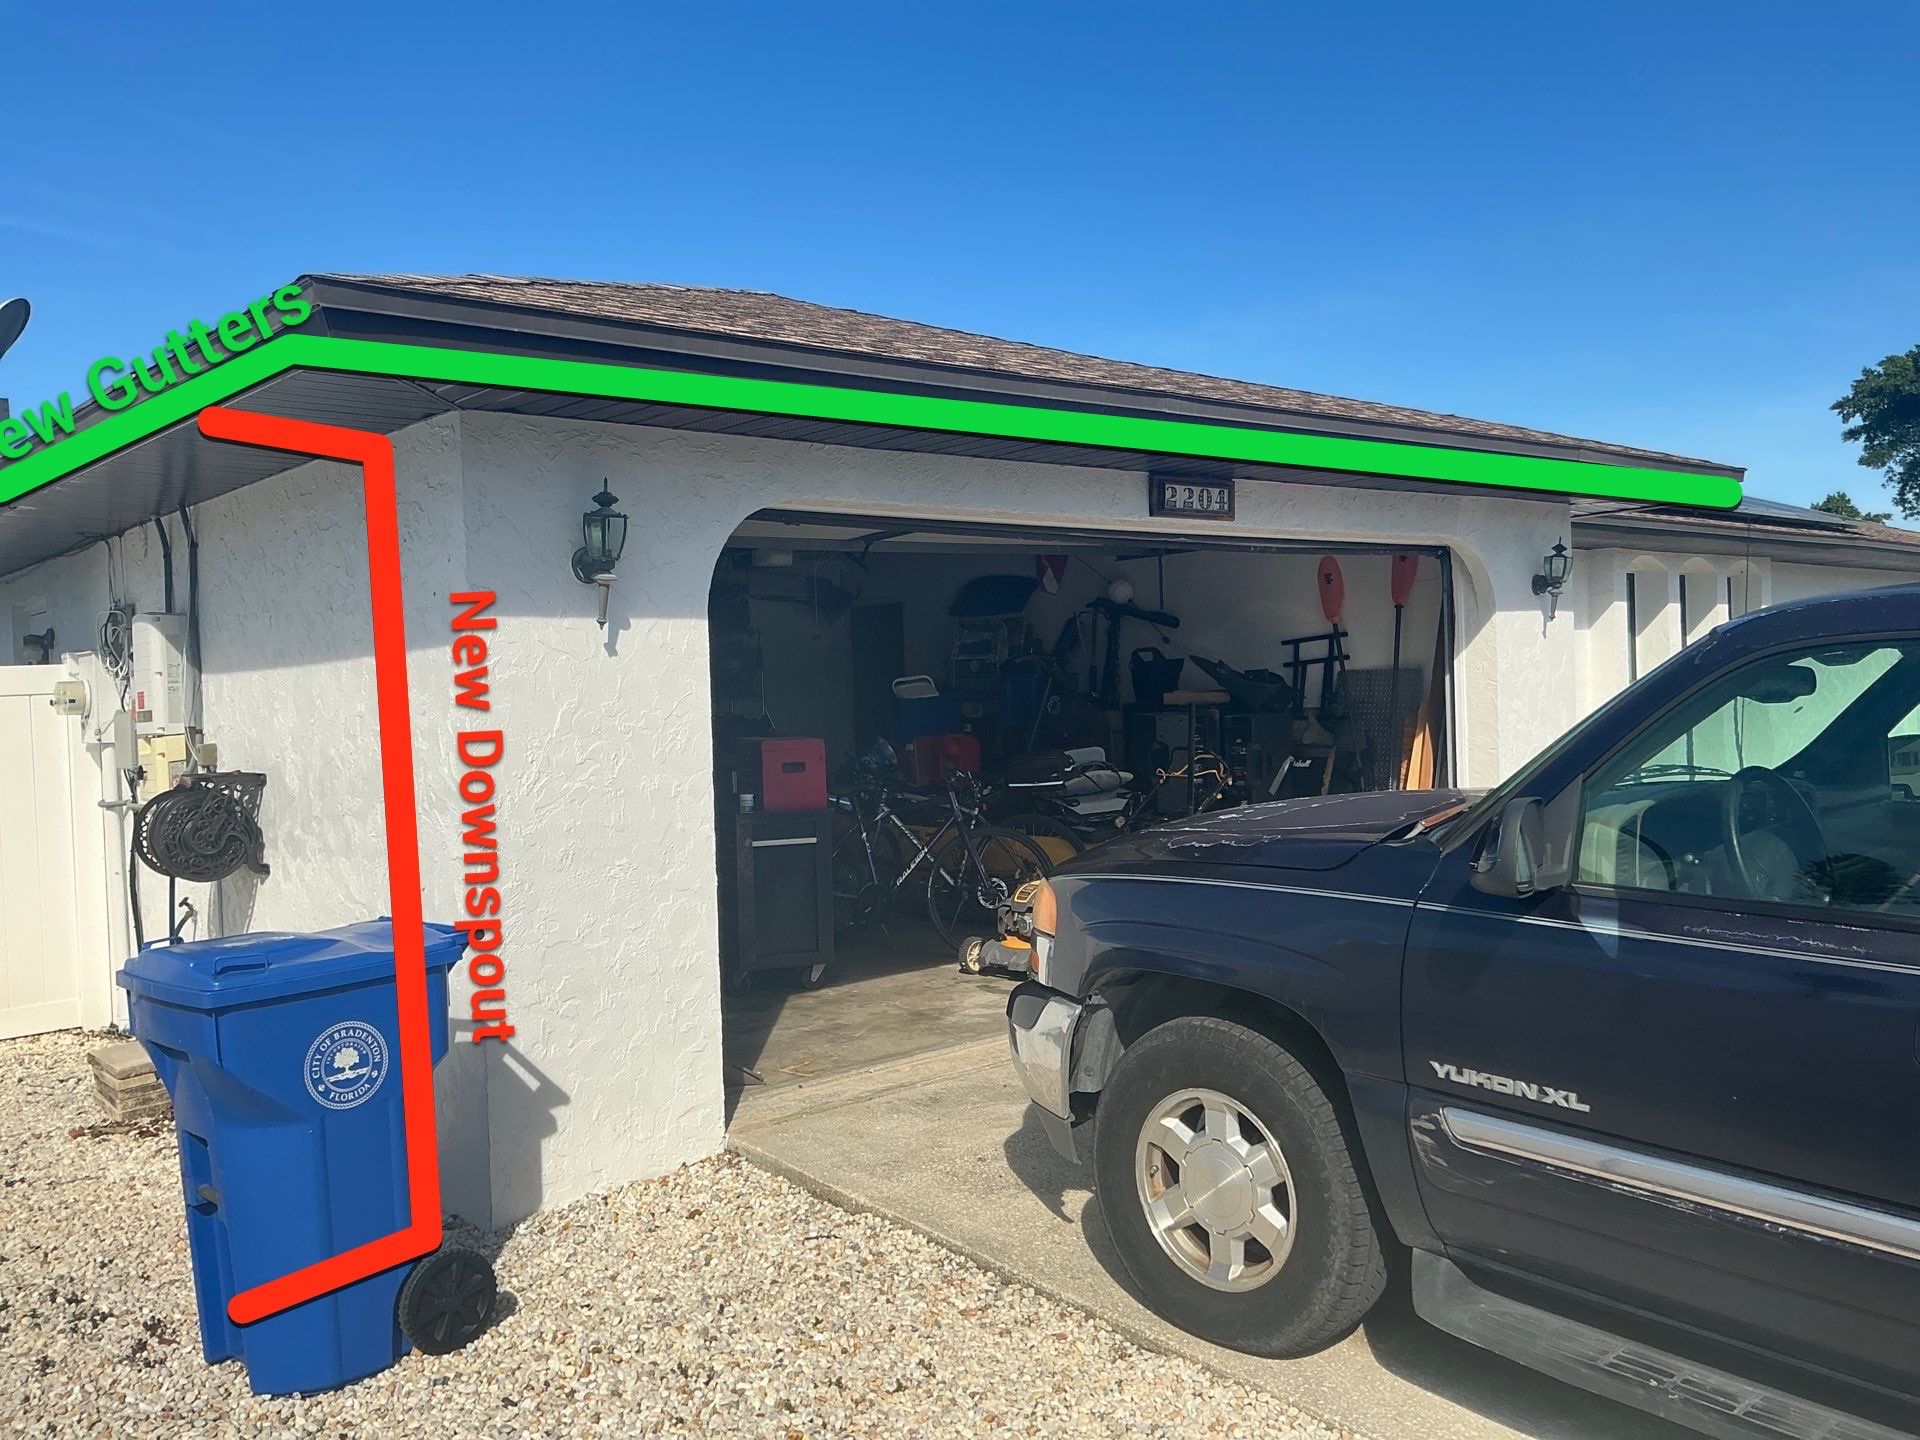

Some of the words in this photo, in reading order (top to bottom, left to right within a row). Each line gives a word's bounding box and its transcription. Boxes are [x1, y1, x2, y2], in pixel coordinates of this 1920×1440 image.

[1166, 485, 1228, 511] 2204
[896, 845, 928, 886] RALEIGH
[311, 1053, 322, 1079] CITY
[320, 1038, 332, 1052] OF
[333, 1028, 382, 1063] BRADENTON
[328, 1083, 371, 1102] FLORIDA
[1429, 1060, 1538, 1101] YUKON
[1540, 1086, 1592, 1113] XL
